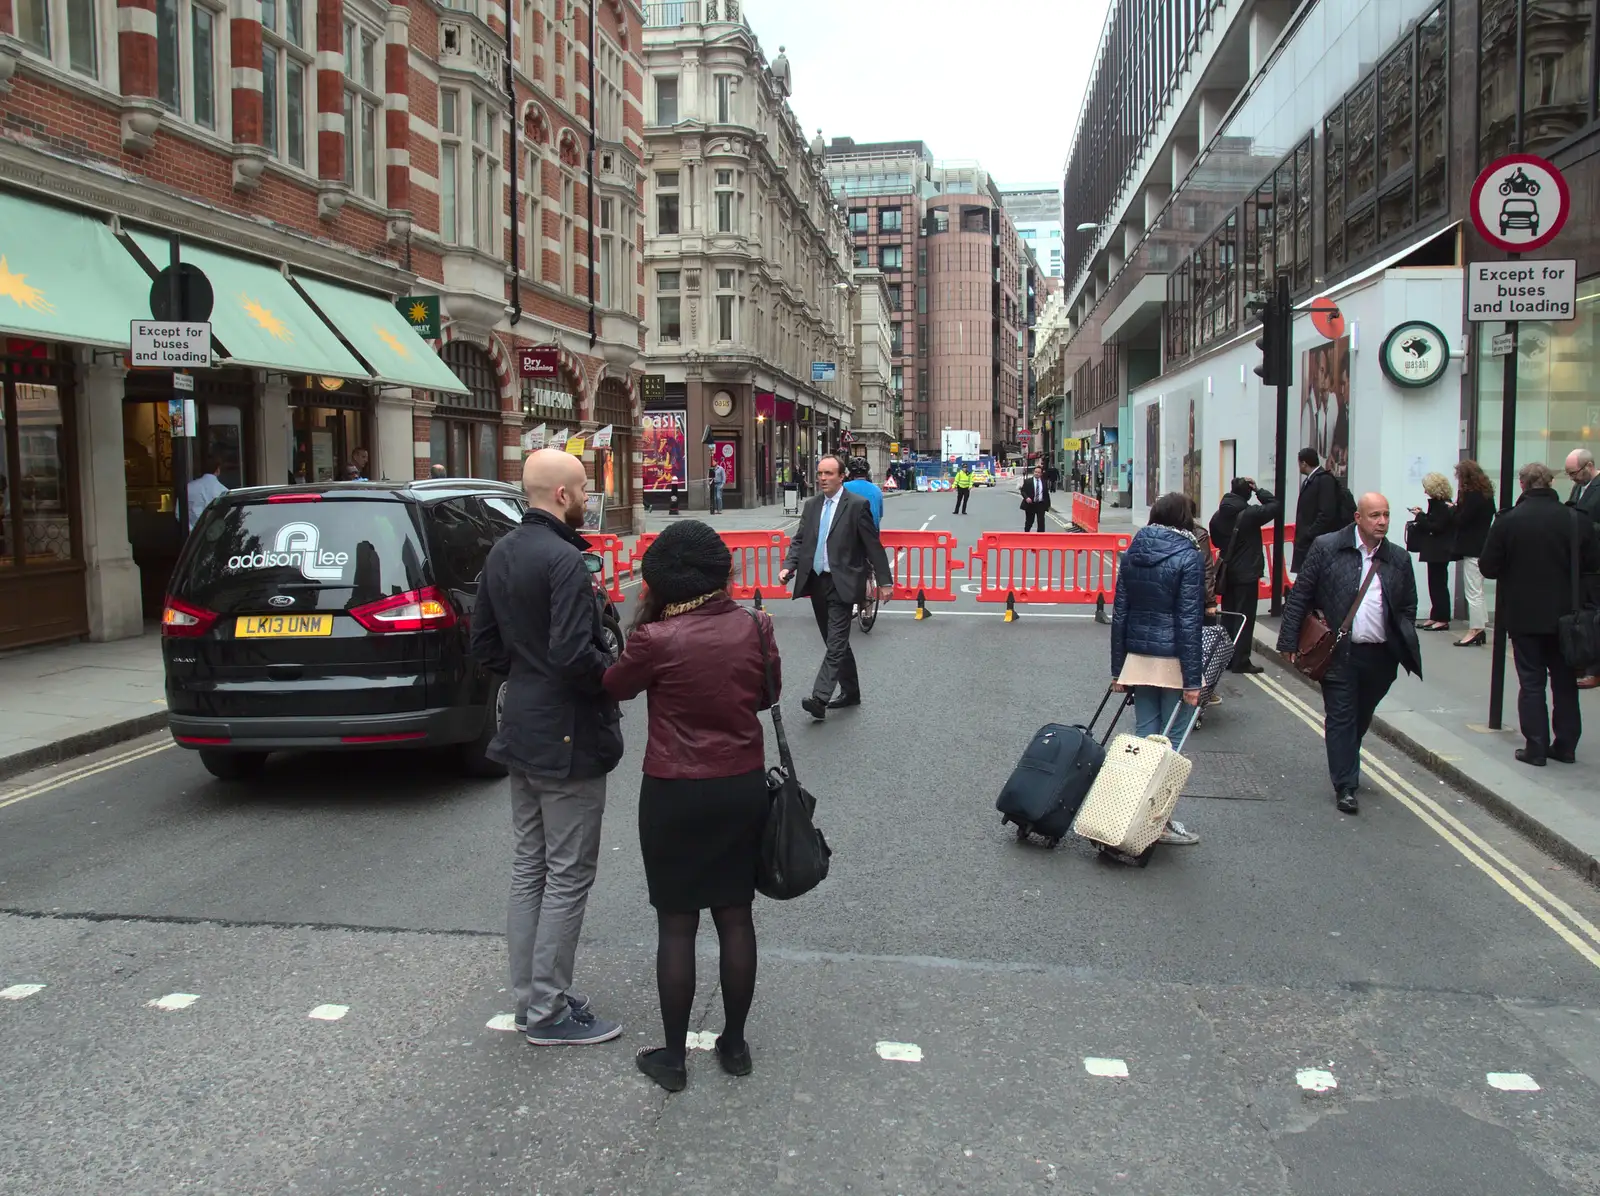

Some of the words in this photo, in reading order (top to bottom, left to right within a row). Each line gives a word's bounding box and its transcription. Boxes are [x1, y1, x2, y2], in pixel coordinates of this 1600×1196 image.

[1479, 267, 1535, 282] Except
[1542, 267, 1565, 279] for
[1497, 284, 1545, 297] buses
[1473, 300, 1503, 313] and
[1509, 299, 1570, 314] loading
[139, 325, 181, 338] Except
[186, 327, 203, 337] for
[153, 338, 189, 349] buses
[135, 351, 158, 361] and
[163, 351, 208, 364] loading
[523, 357, 542, 366] Dry
[1404, 358, 1429, 369] wasabi
[523, 364, 554, 372] Cleaning
[532, 388, 573, 410] TIMPSON
[641, 415, 681, 428] oasis
[228, 550, 301, 569] addison
[318, 548, 349, 566] lee
[246, 617, 284, 634] LK13
[288, 616, 323, 633] UNM
